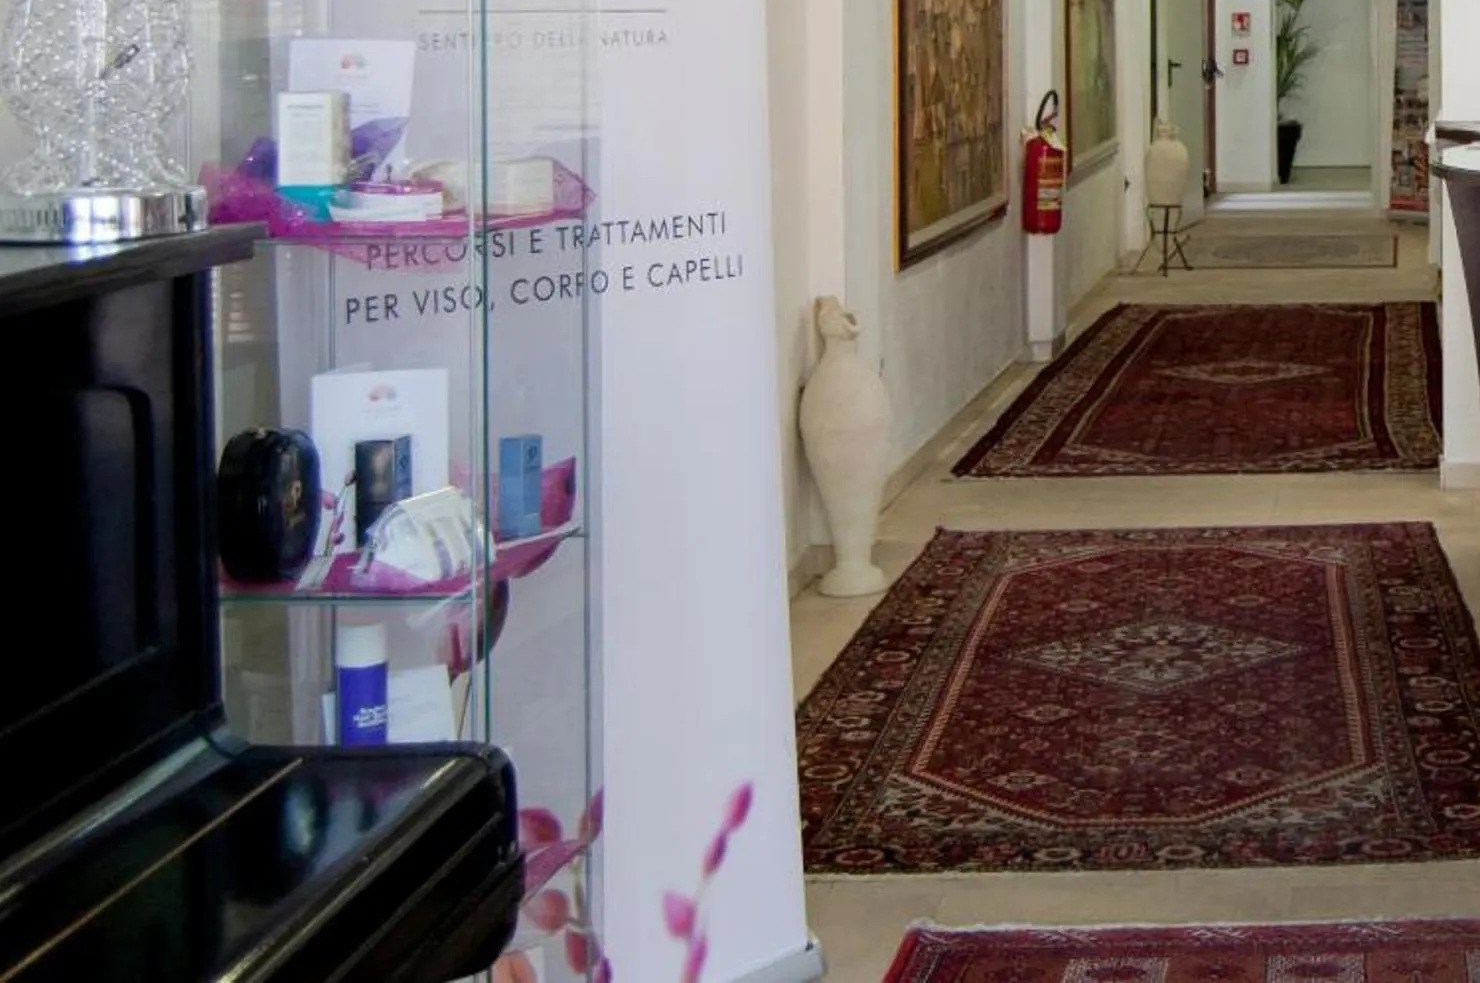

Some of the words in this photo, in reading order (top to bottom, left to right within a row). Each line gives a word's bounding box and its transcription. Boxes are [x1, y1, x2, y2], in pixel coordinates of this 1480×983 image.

[529, 227, 545, 255] E
[556, 211, 727, 251] TRATTAMENTI
[345, 293, 400, 324] PER
[622, 266, 636, 290] E
[647, 254, 744, 289] CAPELLI
